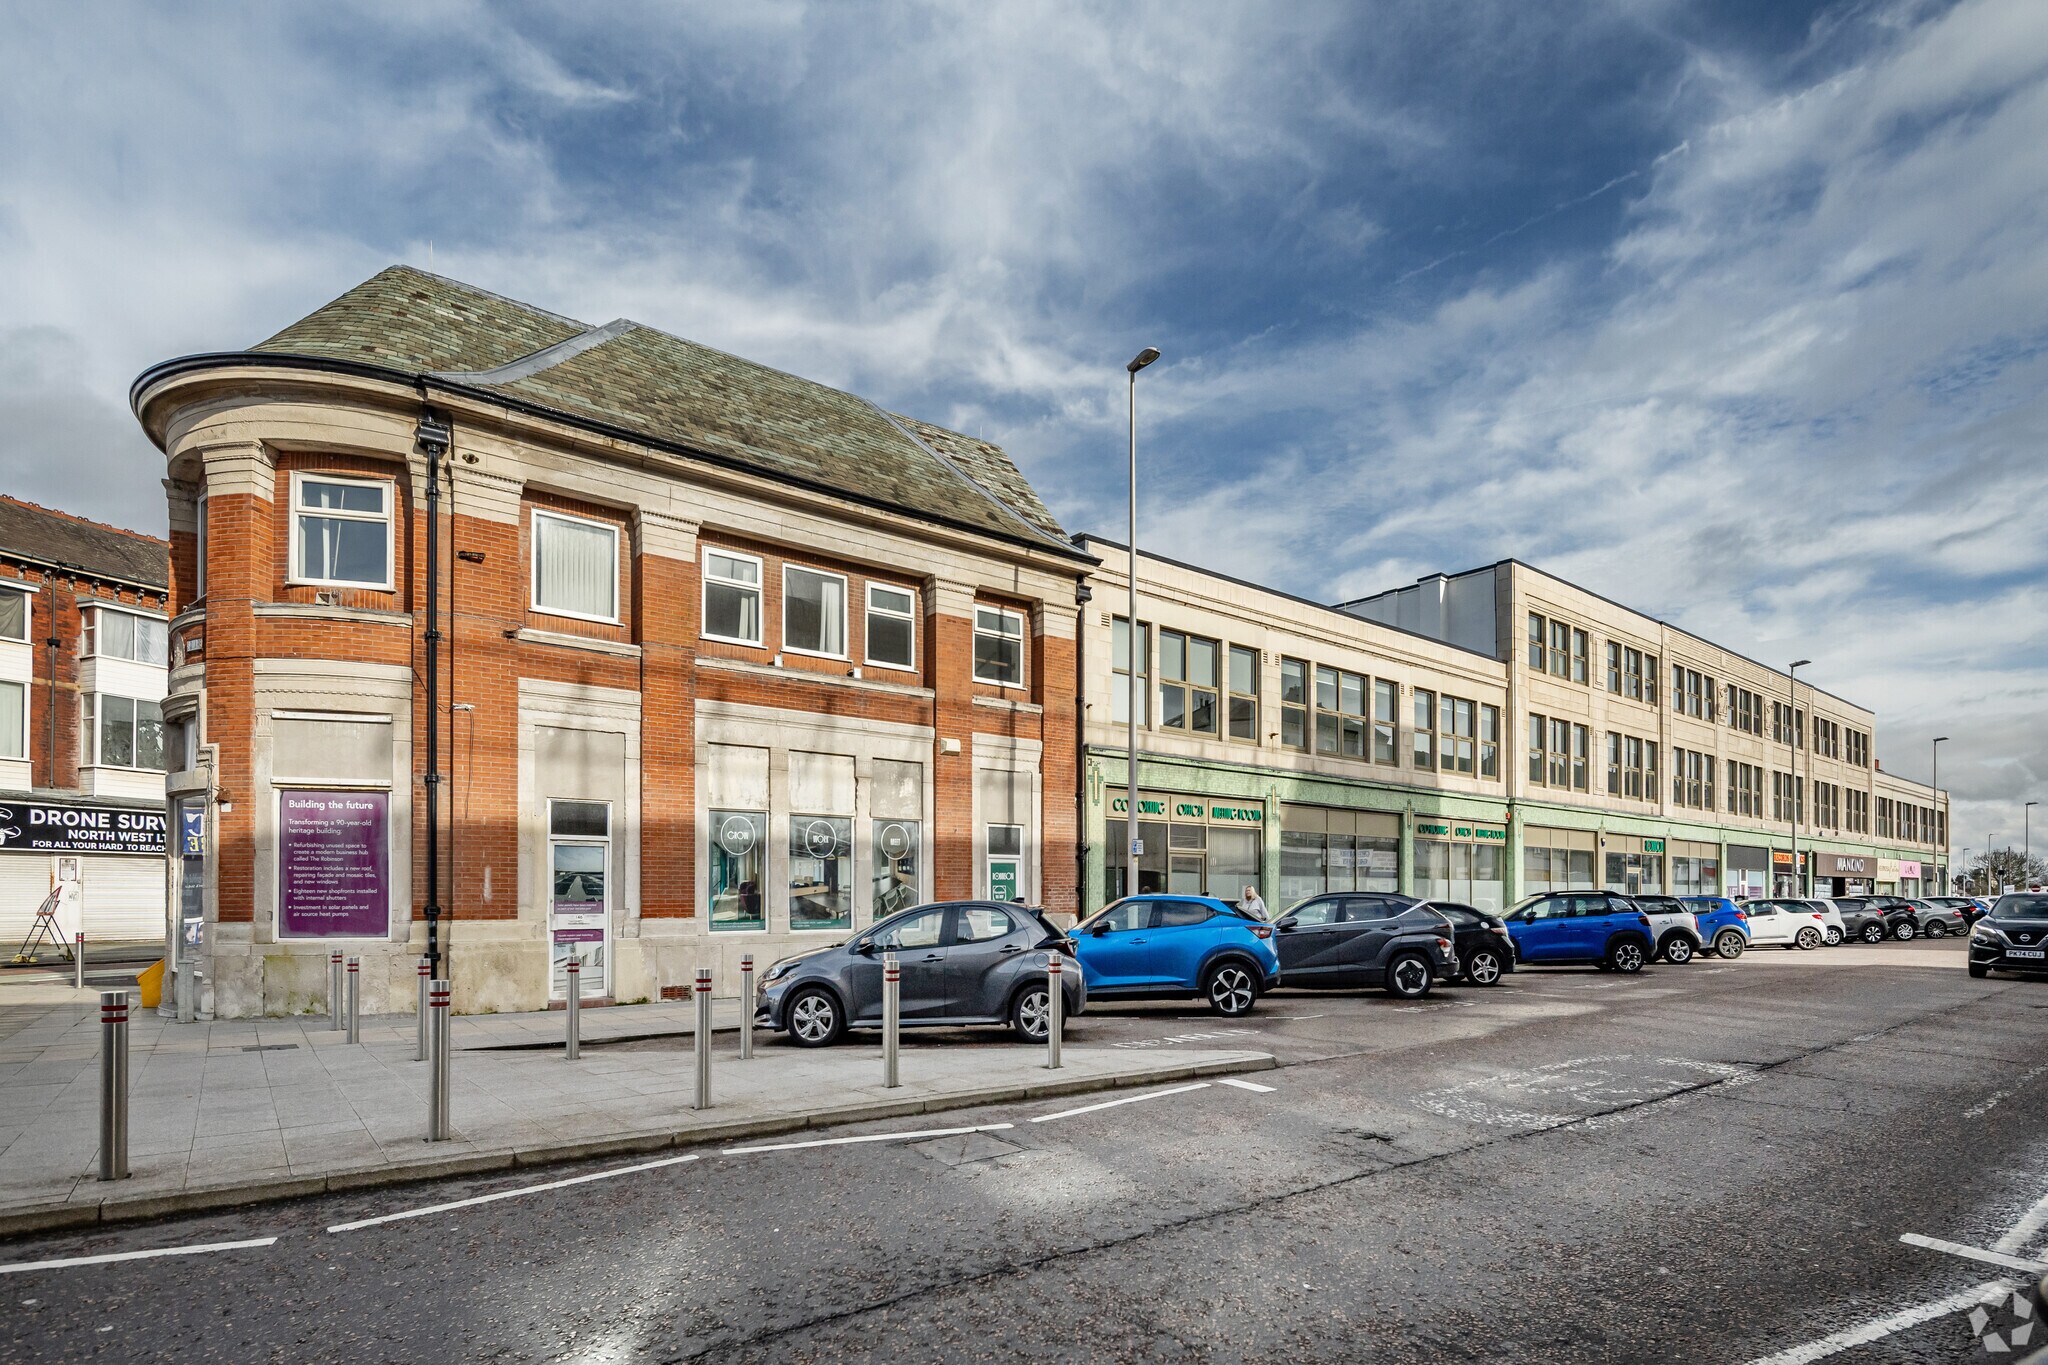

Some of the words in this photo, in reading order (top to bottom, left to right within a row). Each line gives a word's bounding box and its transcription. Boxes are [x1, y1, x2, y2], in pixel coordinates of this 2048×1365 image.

[289, 800, 325, 811] Building
[328, 800, 343, 809] the
[346, 801, 374, 810] future
[30, 809, 110, 828] DRONE
[68, 829, 115, 840] NORTH
[118, 832, 153, 842] WEST
[289, 827, 314, 835] heritage
[1836, 858, 1865, 872] MANKIND
